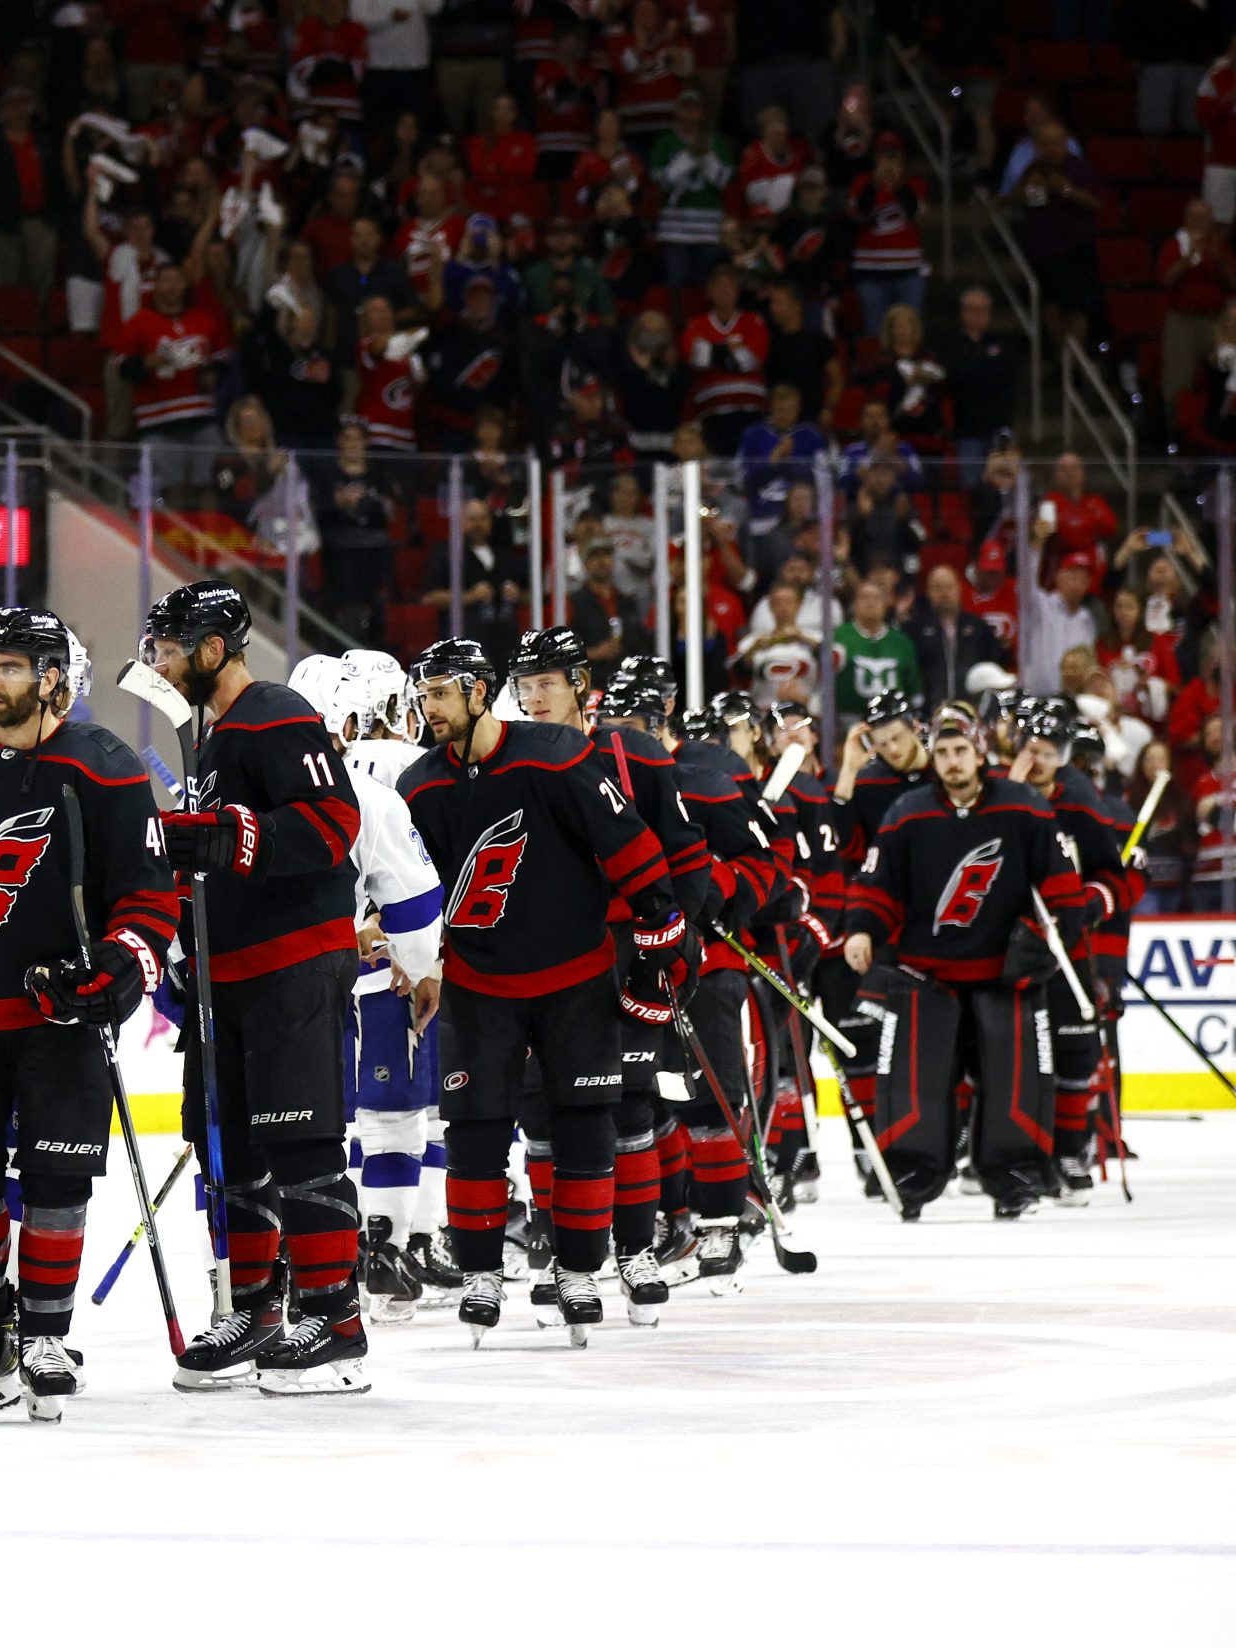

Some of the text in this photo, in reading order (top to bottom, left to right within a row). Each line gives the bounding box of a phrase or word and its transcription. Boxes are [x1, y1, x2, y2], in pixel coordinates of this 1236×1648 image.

[302, 752, 335, 787] 11
[145, 816, 168, 857] 4
[633, 917, 686, 946] BAUER
[117, 929, 159, 993] CCM
[621, 1051, 656, 1063] CM
[574, 1073, 623, 1087] BAUER
[251, 1109, 313, 1125] BAUER
[34, 1139, 102, 1156] BAUER
